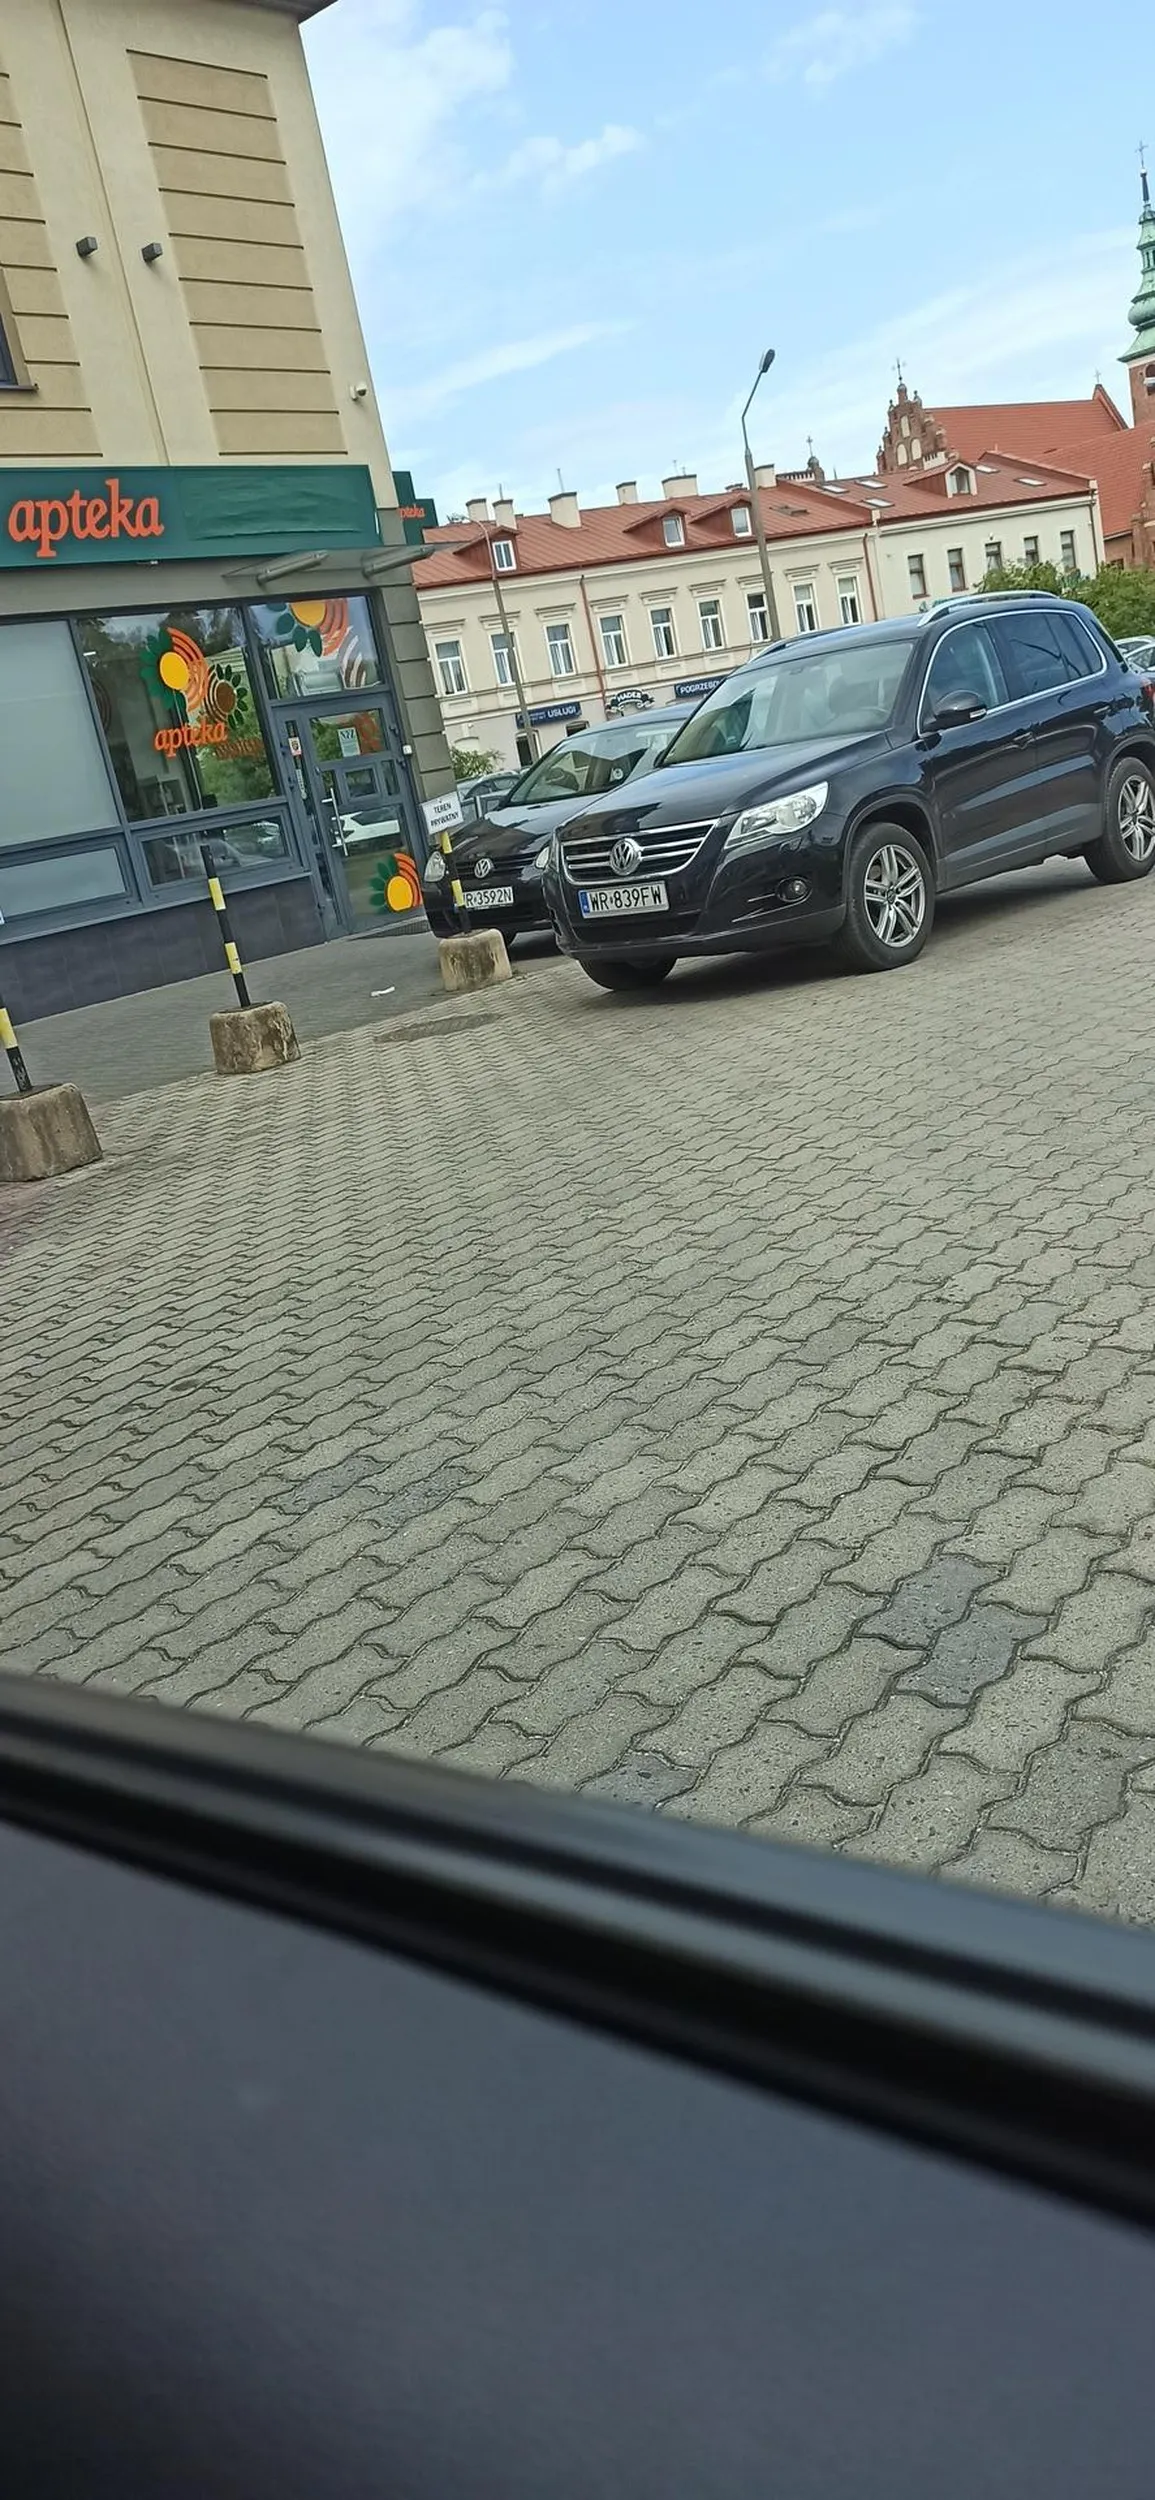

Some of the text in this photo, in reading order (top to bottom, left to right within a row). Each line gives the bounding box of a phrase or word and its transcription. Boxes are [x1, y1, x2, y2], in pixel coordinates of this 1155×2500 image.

[8, 478, 165, 558] apteka
[680, 680, 720, 694] POGRZEBO
[154, 718, 228, 758] apteka
[433, 803, 452, 813] TEREN
[430, 811, 459, 826] PRYWATNY
